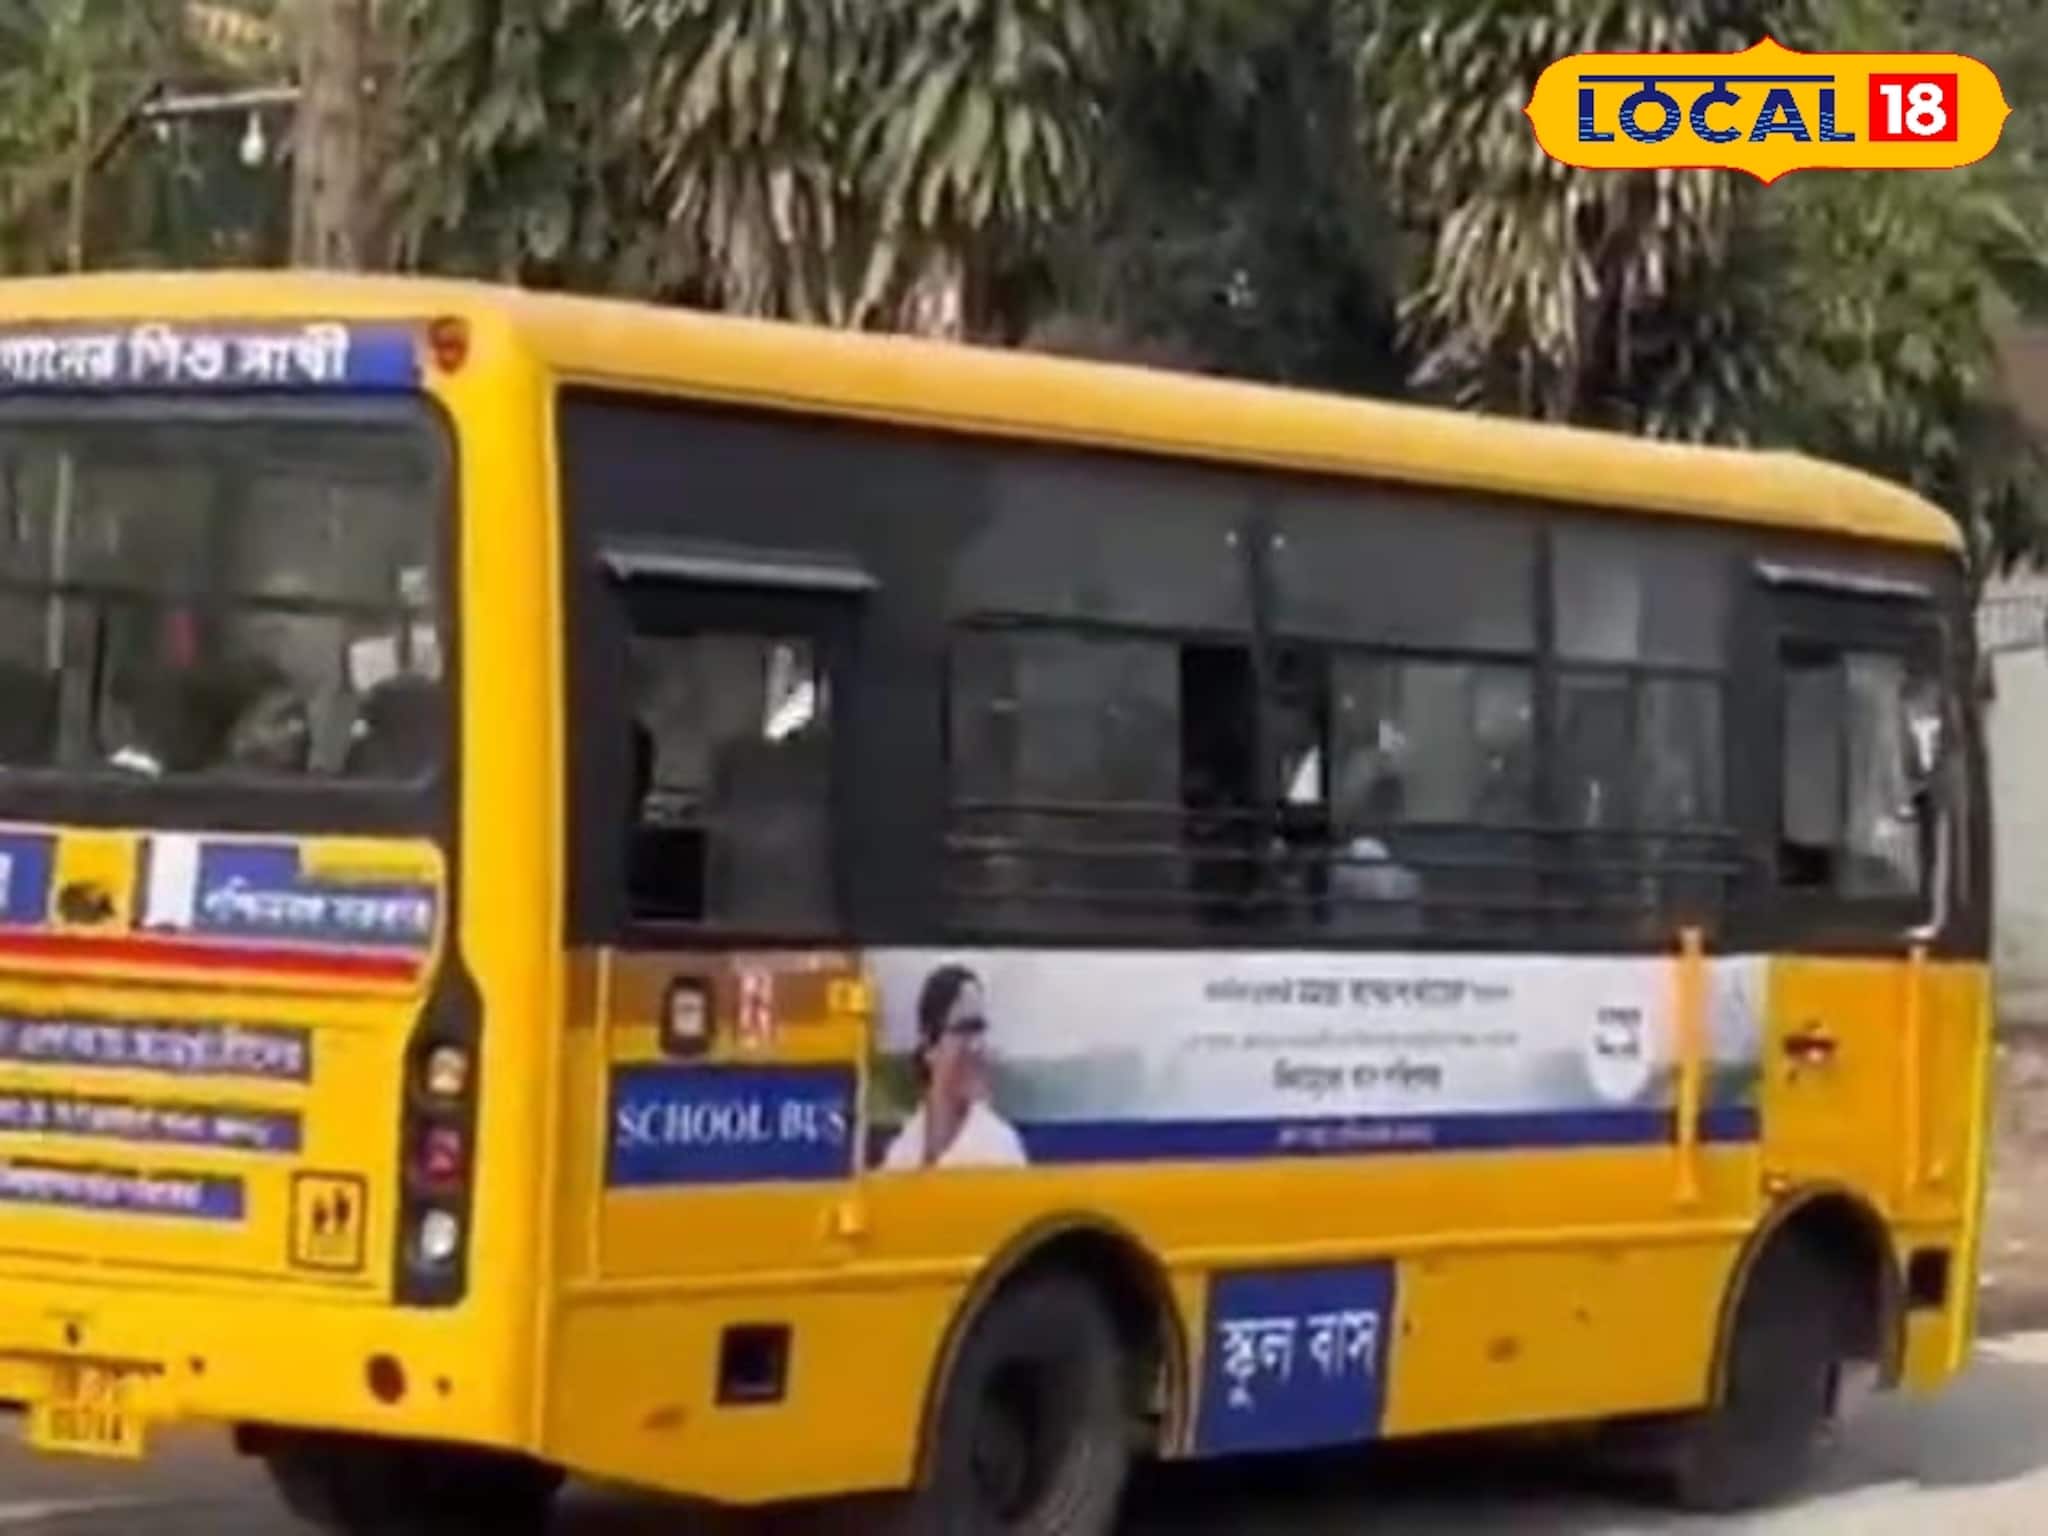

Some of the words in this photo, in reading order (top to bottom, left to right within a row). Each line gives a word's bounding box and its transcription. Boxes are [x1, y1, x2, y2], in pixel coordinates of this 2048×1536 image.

[616, 1102, 767, 1147] SCHOOL
[779, 1098, 846, 1146] BUS
[1221, 1317, 1297, 1412] স্কুল
[1306, 1310, 1377, 1377] বাস
